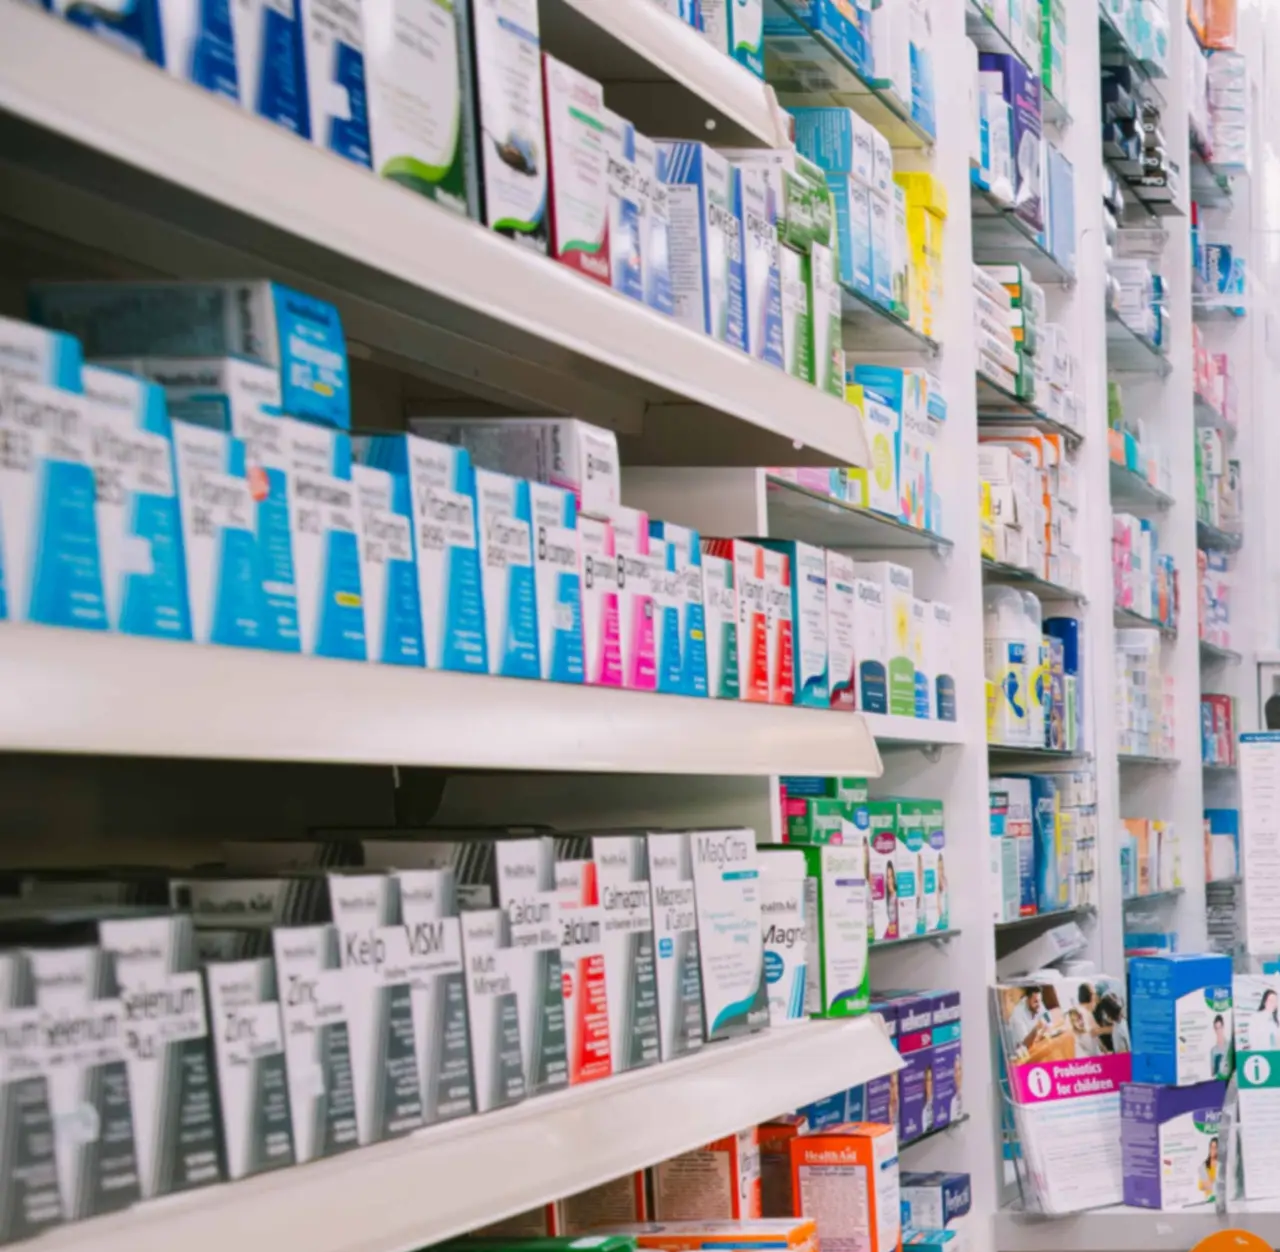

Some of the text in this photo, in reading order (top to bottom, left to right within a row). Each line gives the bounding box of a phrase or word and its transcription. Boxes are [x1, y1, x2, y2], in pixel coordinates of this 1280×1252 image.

[345, 935, 387, 972] Kelp
[1052, 1061, 1103, 1079] Probiotics
[1056, 1077, 1114, 1096] for children
